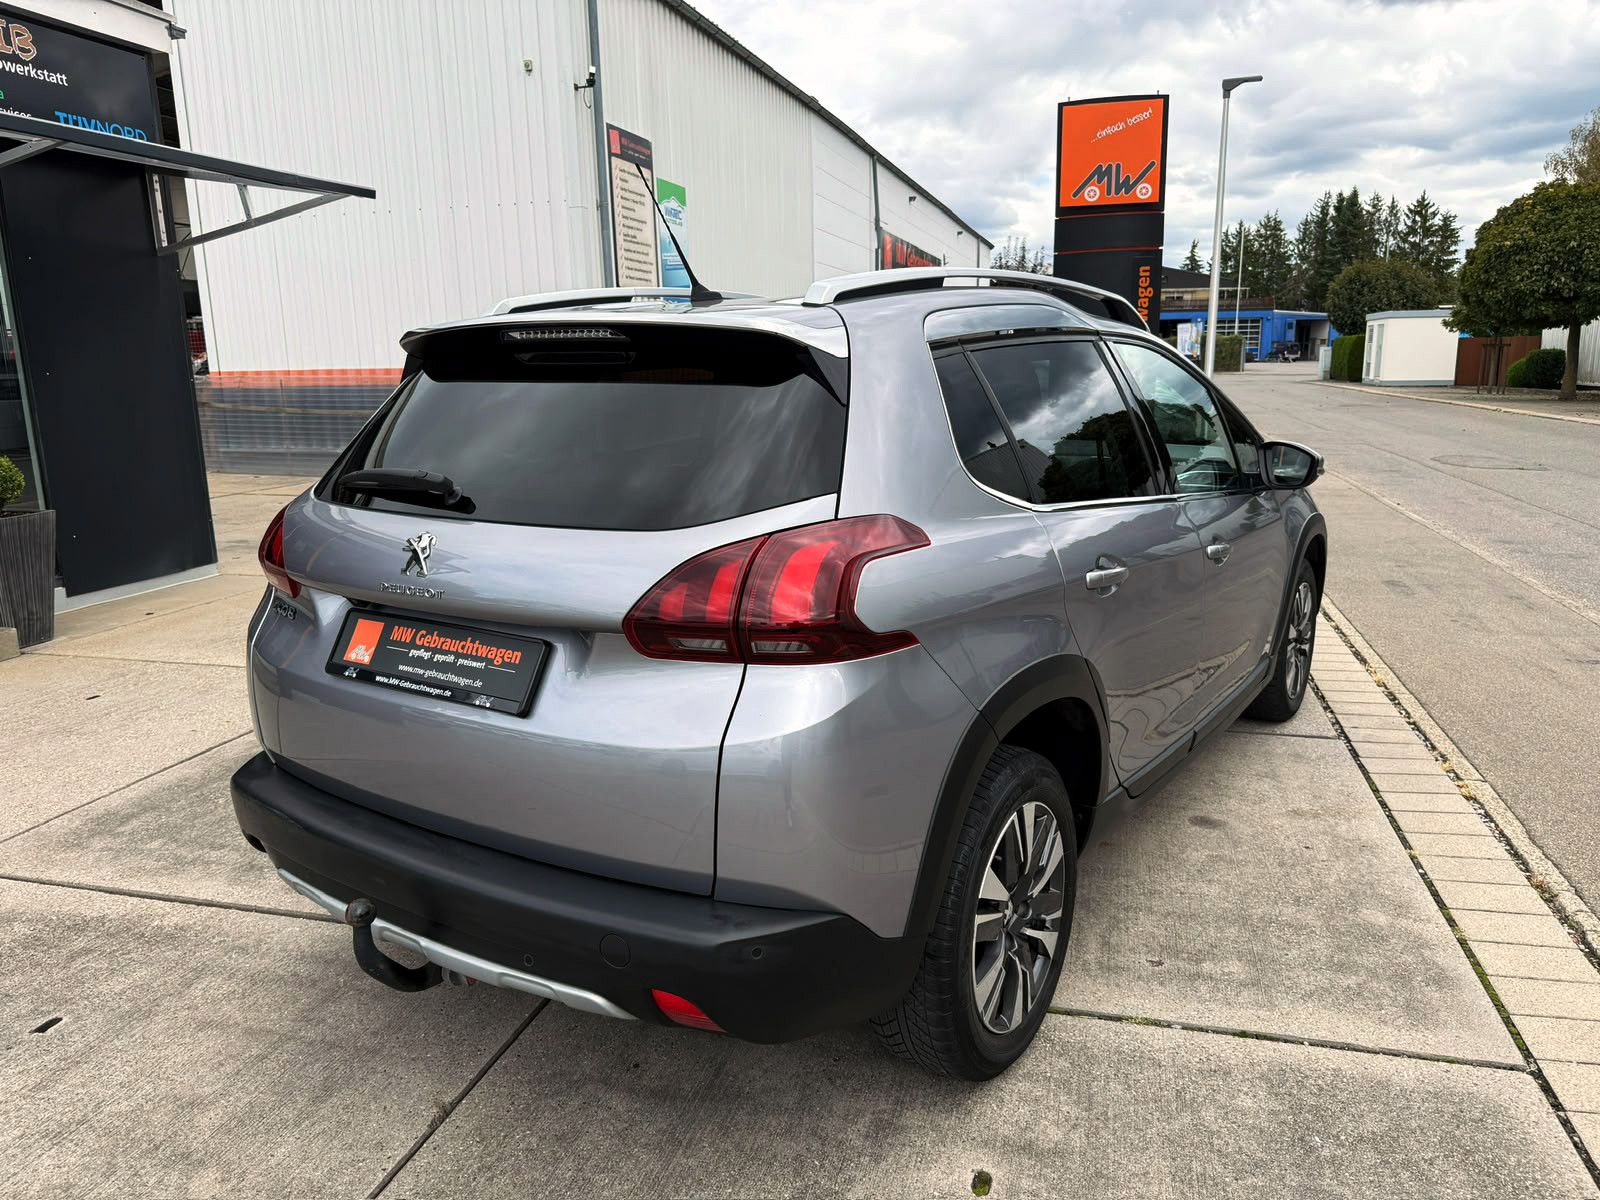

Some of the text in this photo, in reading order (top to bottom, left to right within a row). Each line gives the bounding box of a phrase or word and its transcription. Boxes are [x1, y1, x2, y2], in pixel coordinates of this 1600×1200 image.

[1072, 160, 1157, 199] MW
[378, 581, 446, 600] PEUGEOT
[389, 626, 523, 666] MW Gebrauchtwagen
[408, 648, 486, 669] gepflegt geprüft preiswert
[375, 675, 452, 697] www.MW-Gebrauchtwagen.de
[398, 664, 483, 688] www.mw-gebrauchtwagen.de
